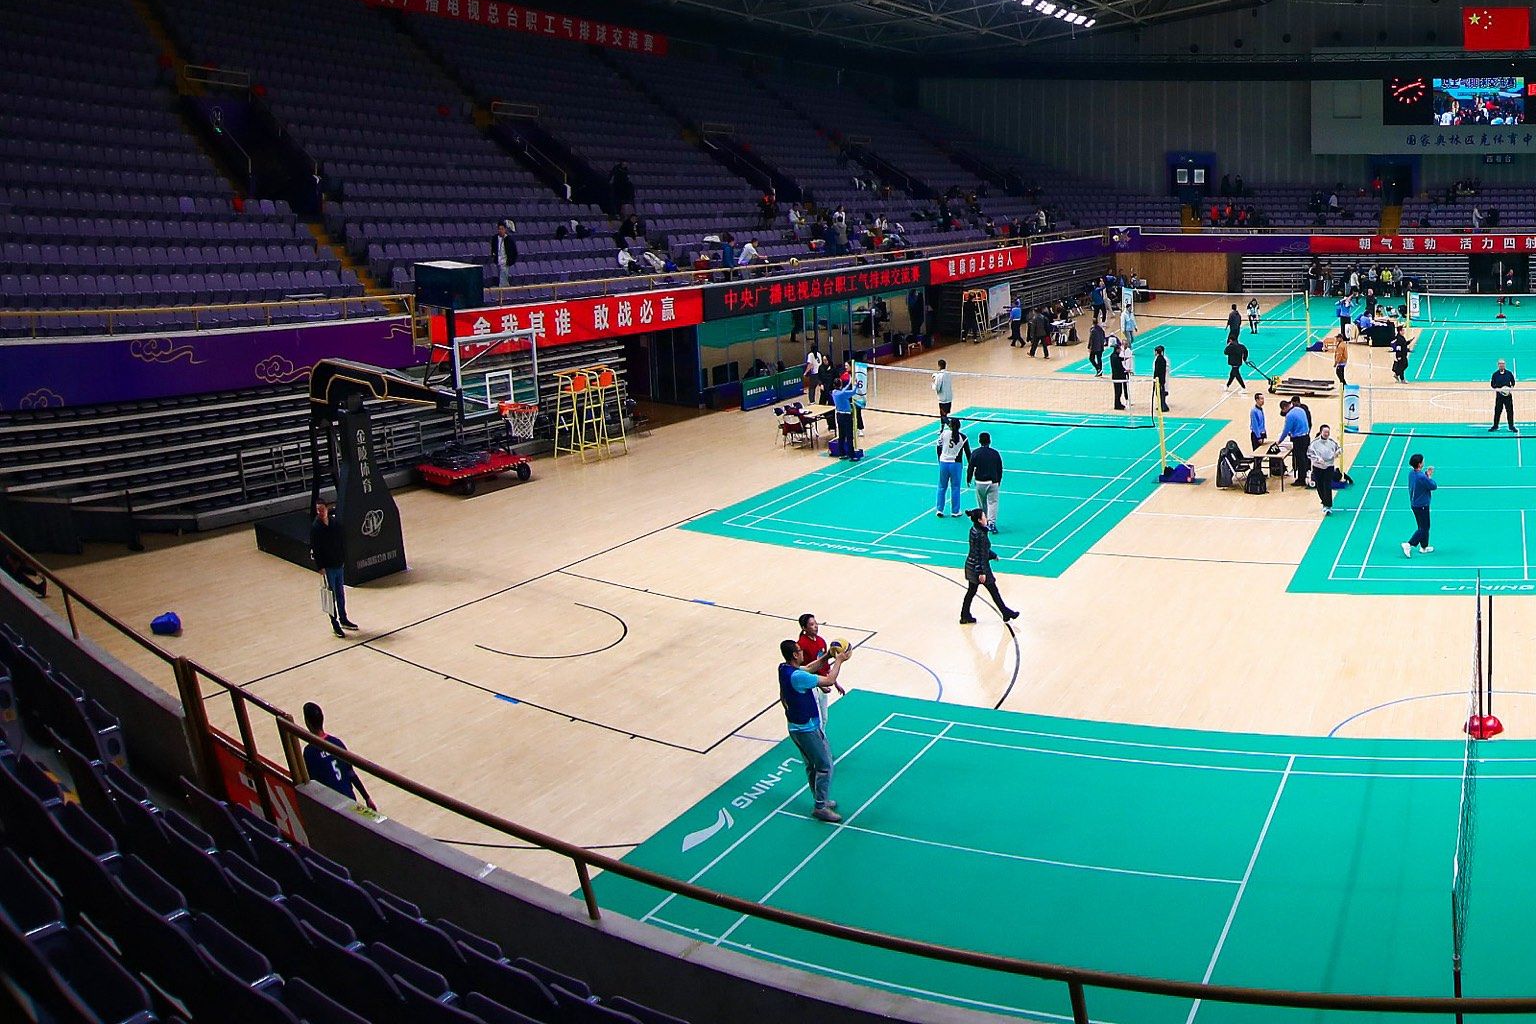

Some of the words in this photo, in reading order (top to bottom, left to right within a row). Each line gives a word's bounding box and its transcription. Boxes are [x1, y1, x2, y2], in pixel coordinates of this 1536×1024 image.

[1359, 238, 1436, 250] 朝气蓬勃
[949, 251, 1014, 277] 健康向上总台人
[724, 264, 920, 311] 中央广播电视总台职工气排球交流赛
[594, 296, 676, 331] 敢战必赢
[1348, 403, 1355, 413] 4
[331, 759, 342, 781] 5
[731, 757, 804, 809] LI-NING
